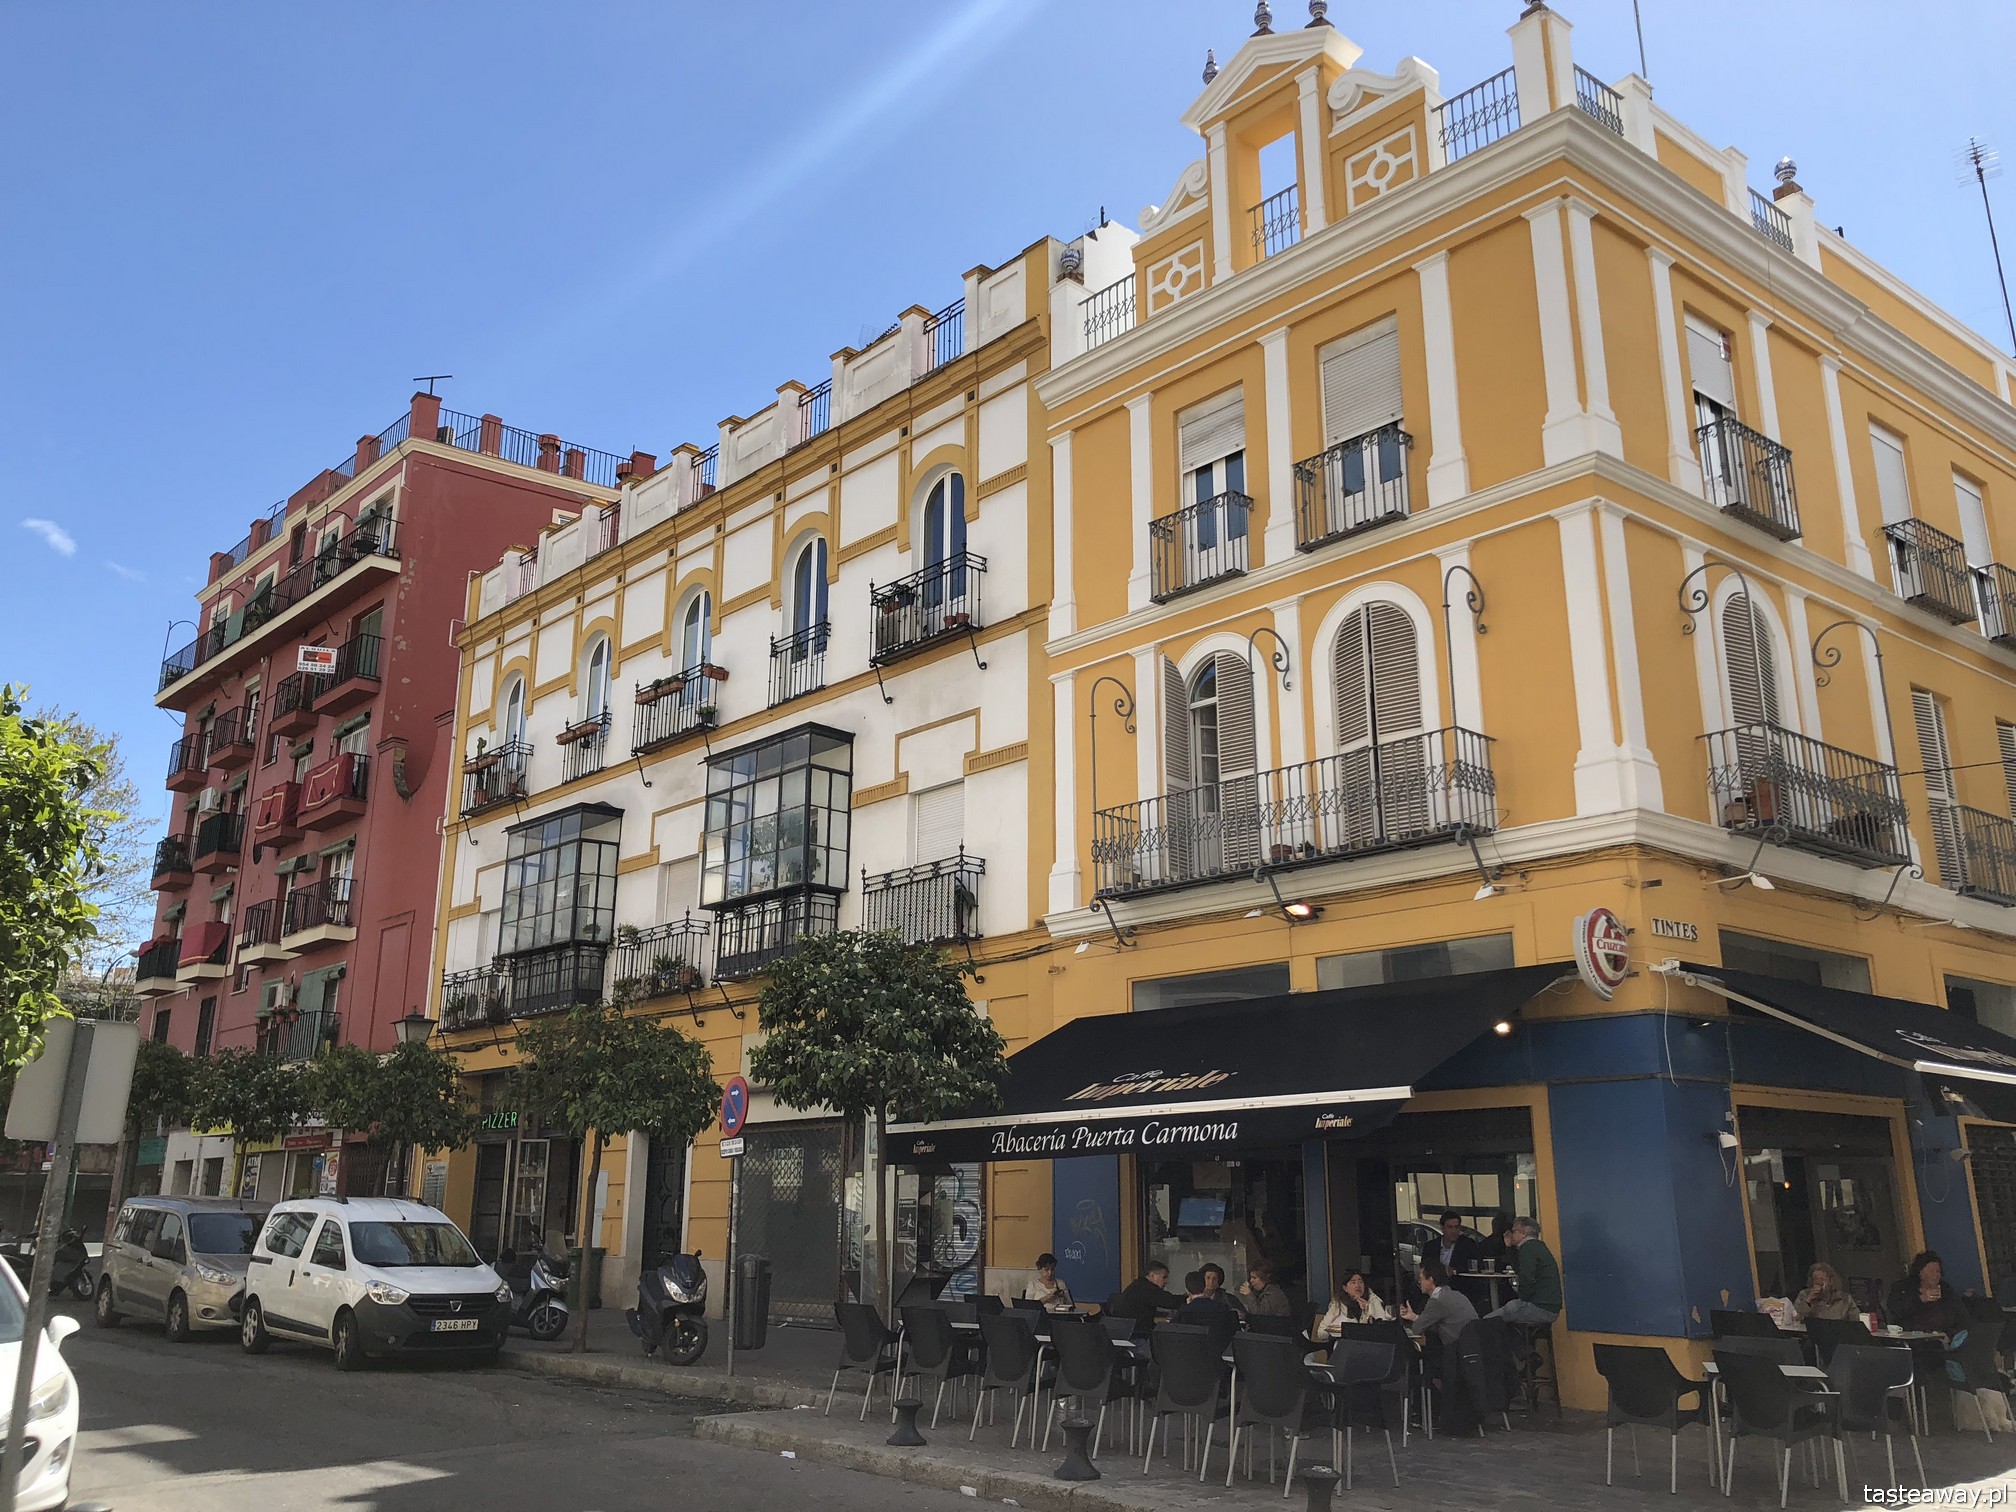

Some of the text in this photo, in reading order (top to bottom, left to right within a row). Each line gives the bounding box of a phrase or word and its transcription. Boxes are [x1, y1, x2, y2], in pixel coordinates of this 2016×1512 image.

[1652, 918, 1698, 940] TINTES
[1062, 1070, 1229, 1101] Imperiale
[482, 1112, 518, 1129] PIZZER
[992, 1122, 1238, 1154] Abacería Puerta Carmona
[436, 1320, 477, 1330] 2346 HPY
